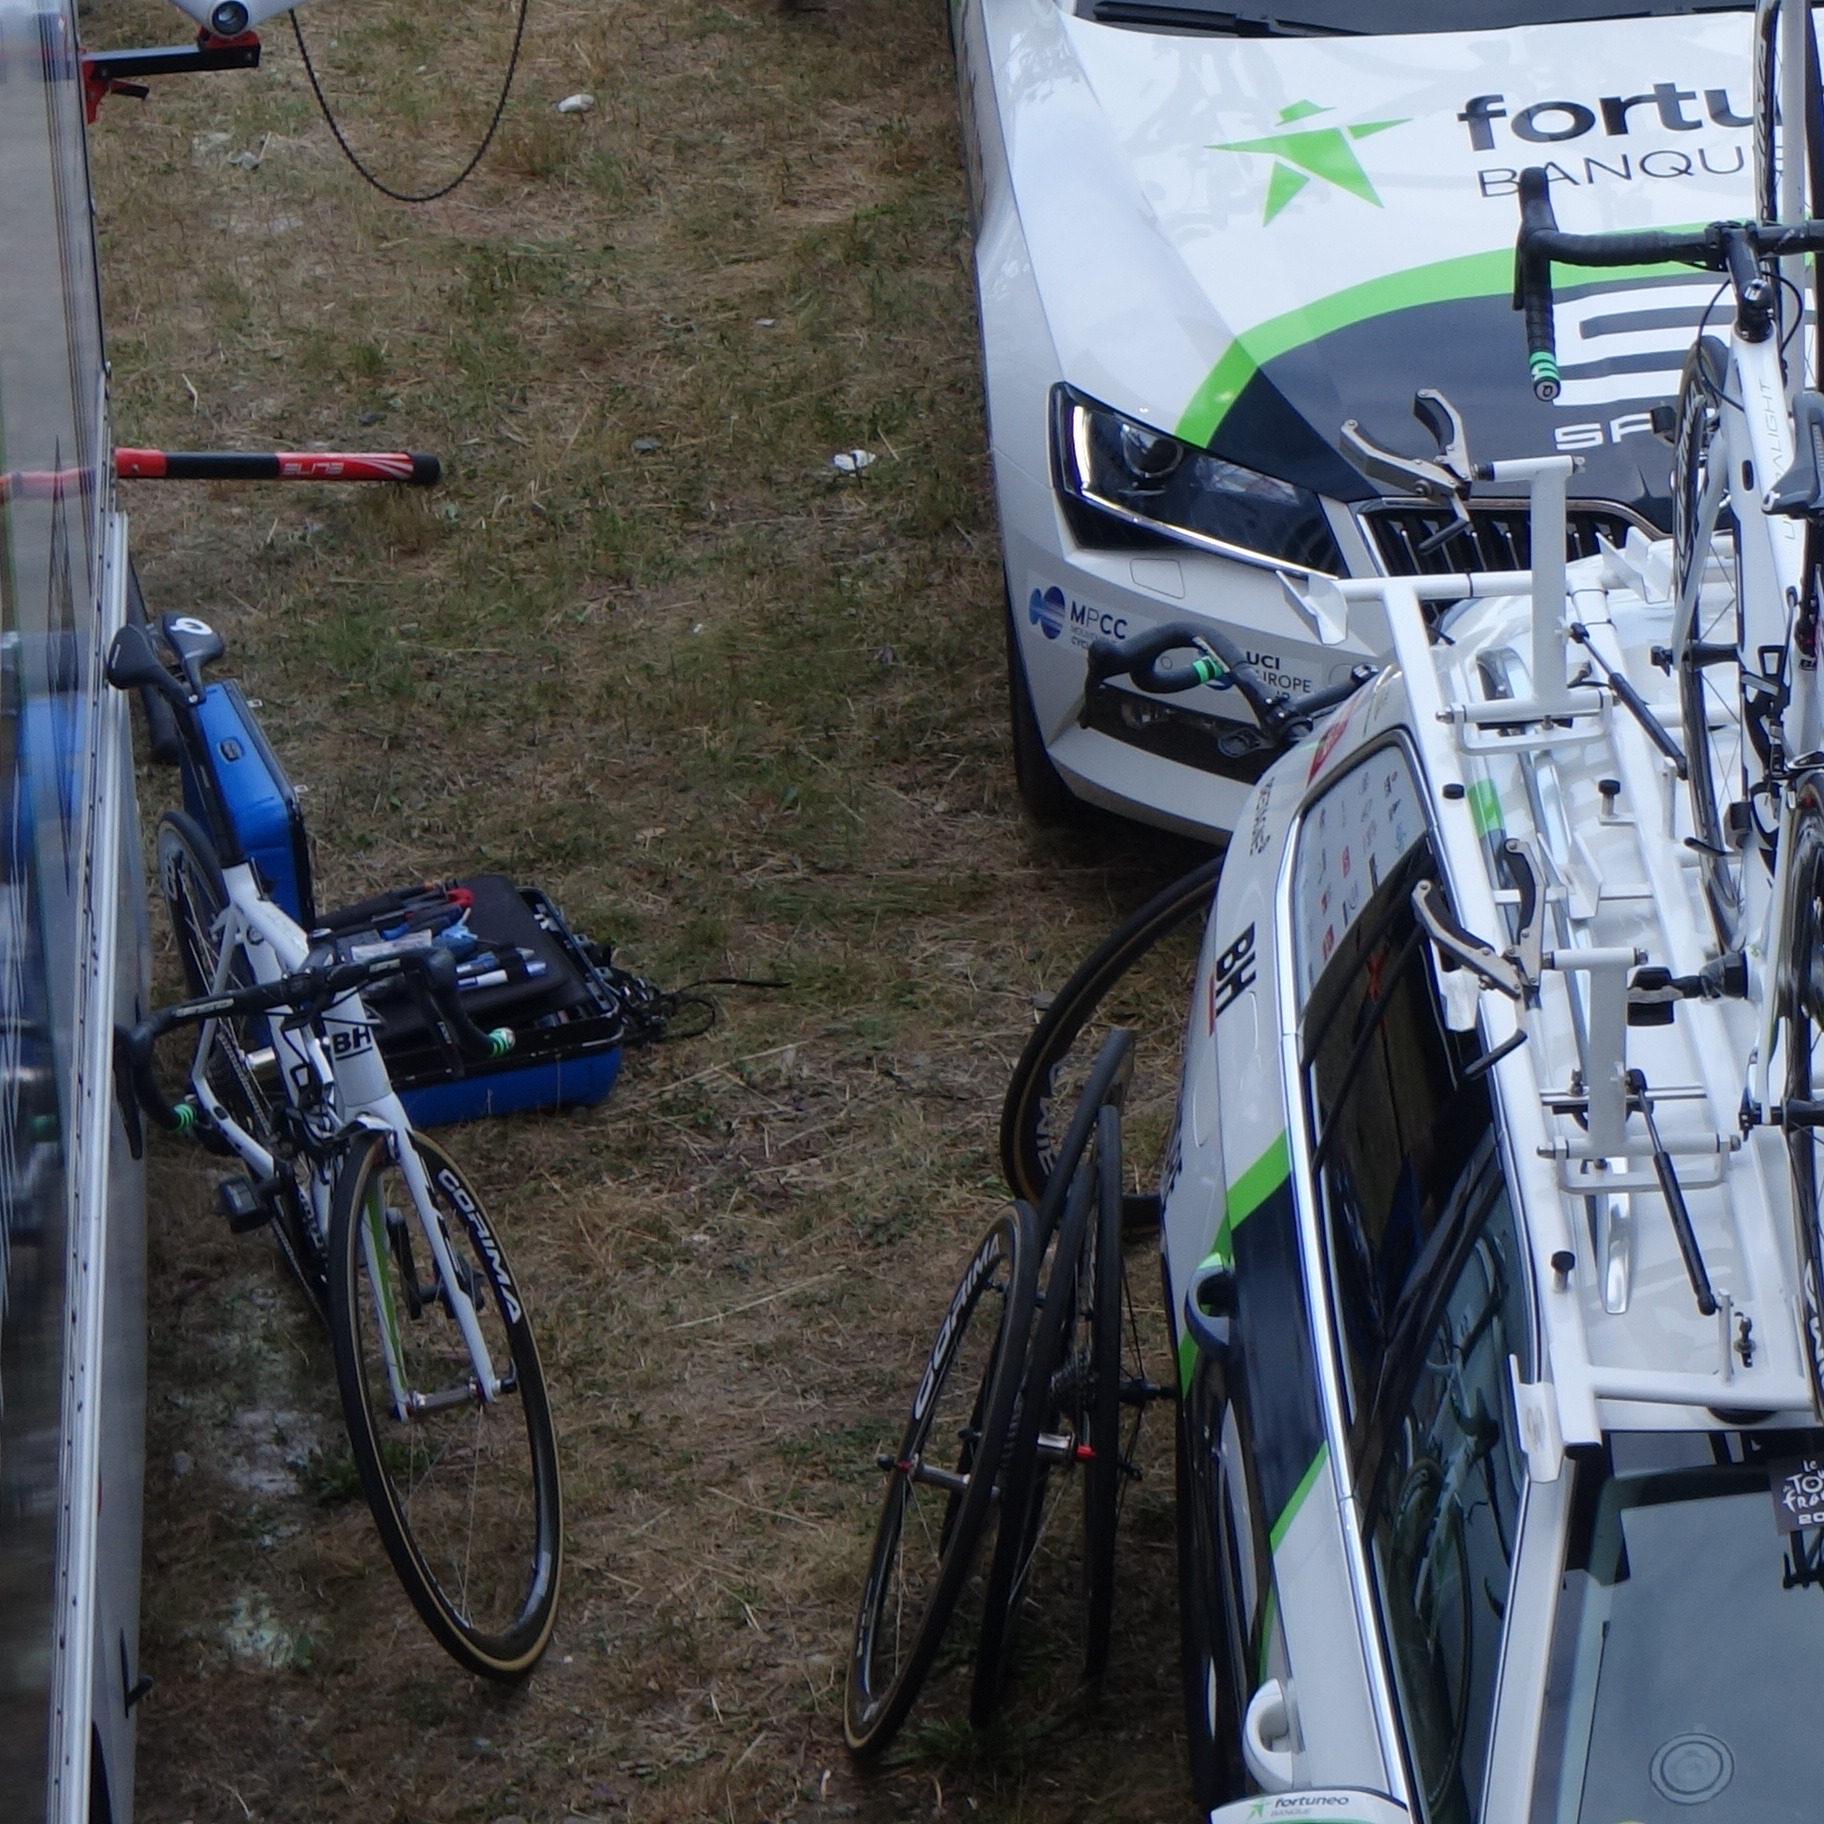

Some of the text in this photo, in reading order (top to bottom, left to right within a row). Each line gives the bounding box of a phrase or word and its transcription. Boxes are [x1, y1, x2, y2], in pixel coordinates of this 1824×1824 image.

[1477, 142, 1785, 199] BANQU
[1070, 600, 1128, 640] MPCC
[1246, 650, 1280, 670] UCI
[1215, 922, 1256, 1020] BH
[331, 1021, 372, 1055] BH
[436, 1167, 524, 1325] CORIMA
[913, 1235, 1001, 1423] CORIMA
[1274, 1795, 1351, 1809] fortuneo
